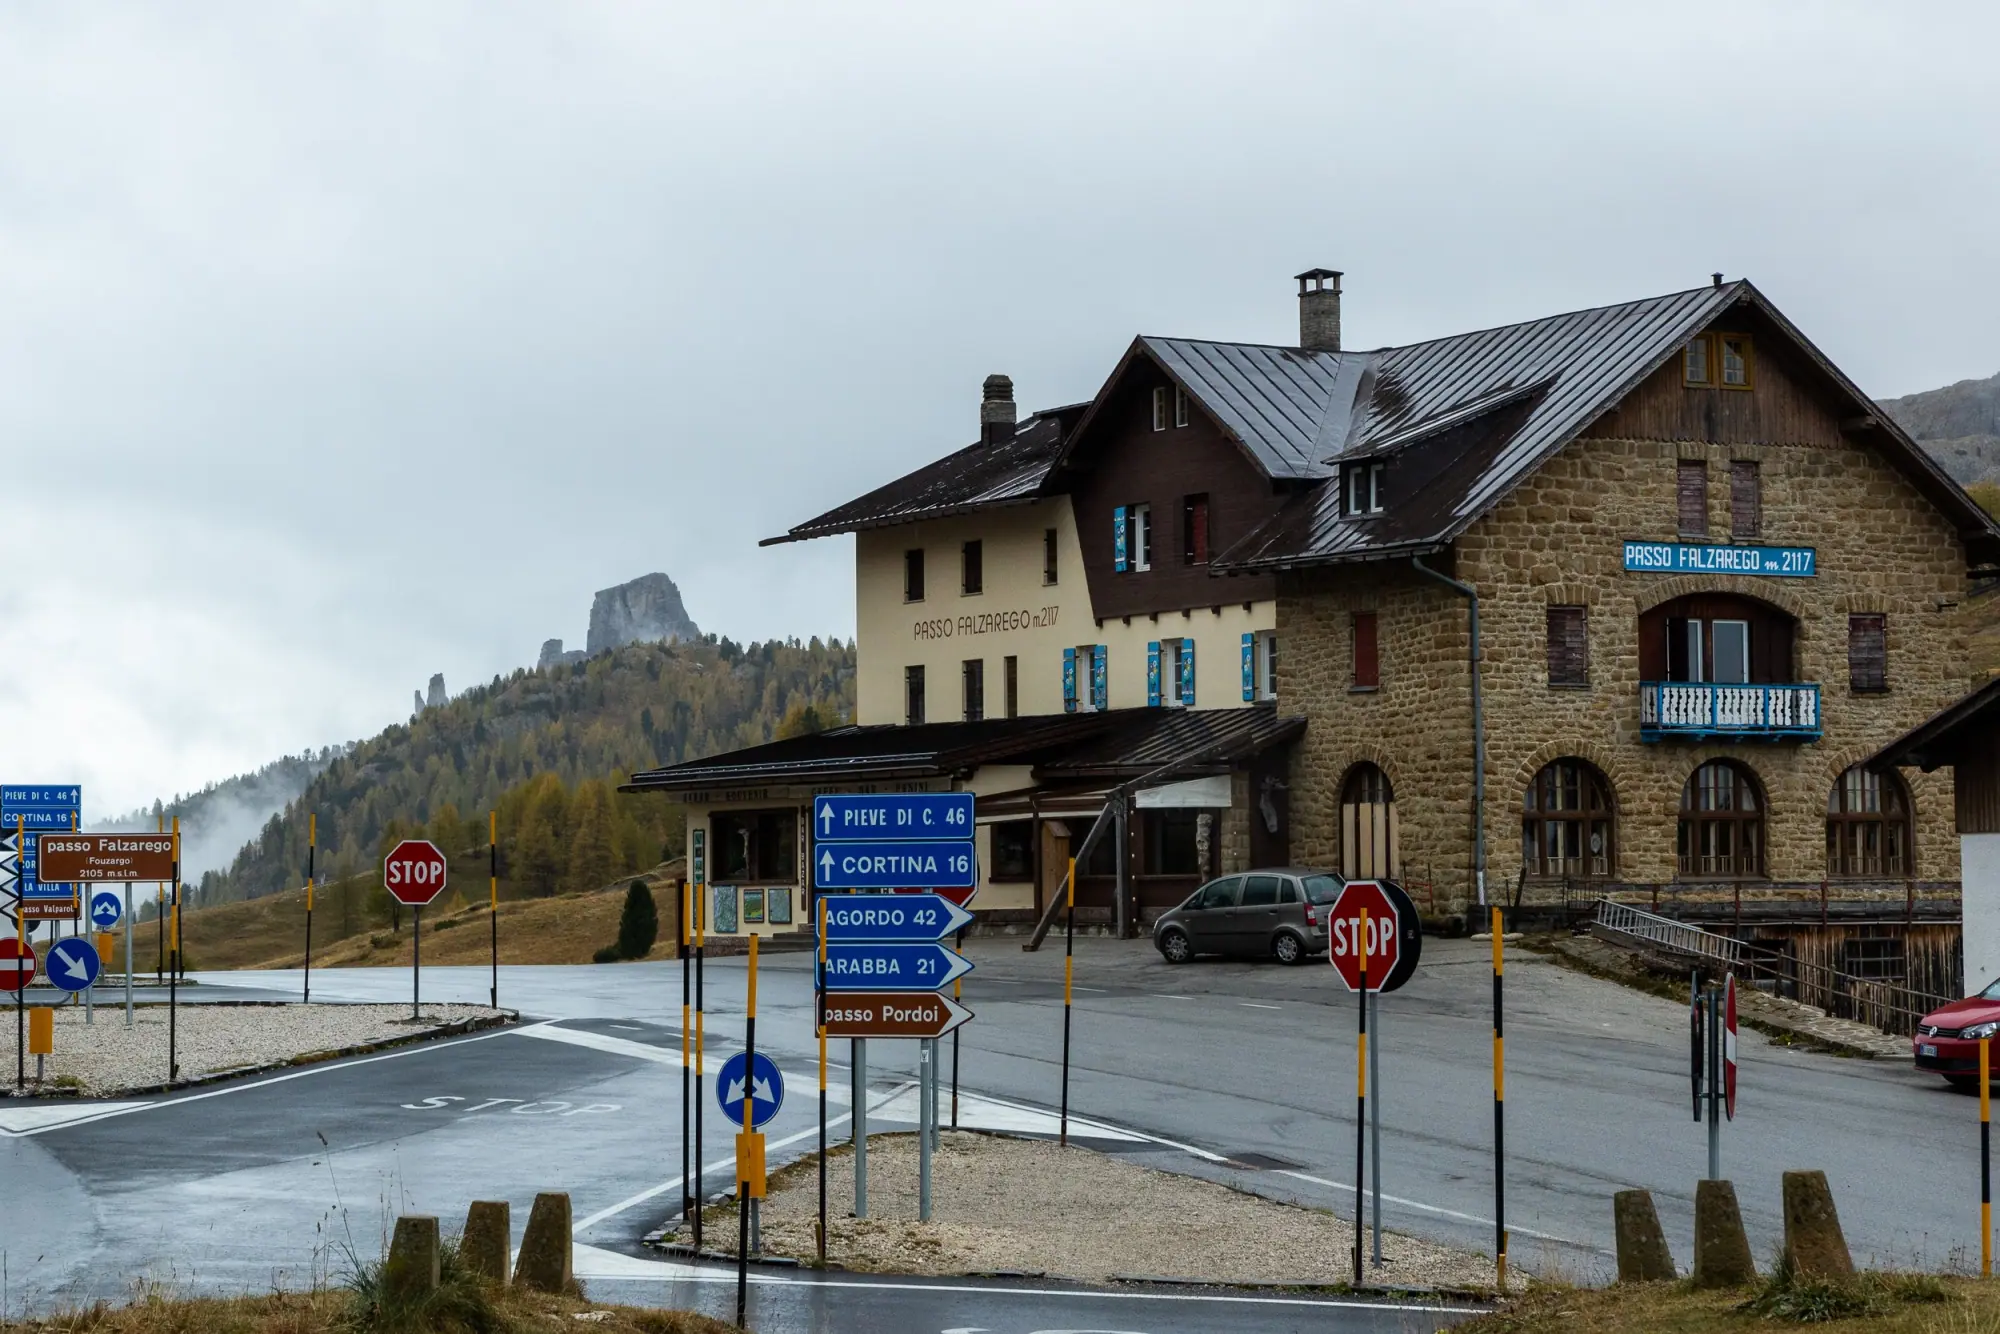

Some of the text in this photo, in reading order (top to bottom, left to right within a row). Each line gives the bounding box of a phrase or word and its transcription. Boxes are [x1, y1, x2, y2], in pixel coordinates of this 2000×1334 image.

[1625, 545, 1672, 567] PASSO
[1679, 547, 1760, 570] FALZAREGO
[914, 618, 953, 640] PASSO
[957, 610, 1030, 635] FALZAREGO
[5, 791, 26, 800] PIEVE
[31, 791, 39, 800] DI
[57, 791, 67, 800] 46
[56, 813, 67, 822] 16
[844, 807, 966, 826] PIEVE DI C. 46
[47, 839, 172, 854] passo Falzarego
[389, 860, 443, 884] STOP
[842, 855, 969, 874] CORTINA 16
[79, 869, 103, 878] 2105
[24, 882, 33, 892] LA
[38, 883, 60, 892] VILLA
[23, 905, 40, 913] asso
[825, 909, 937, 926] AGORDO 42
[1333, 917, 1394, 957] STOP
[825, 958, 935, 974] ARABBA 21
[882, 1005, 939, 1022] Pordoi
[400, 1096, 622, 1117] STOP
